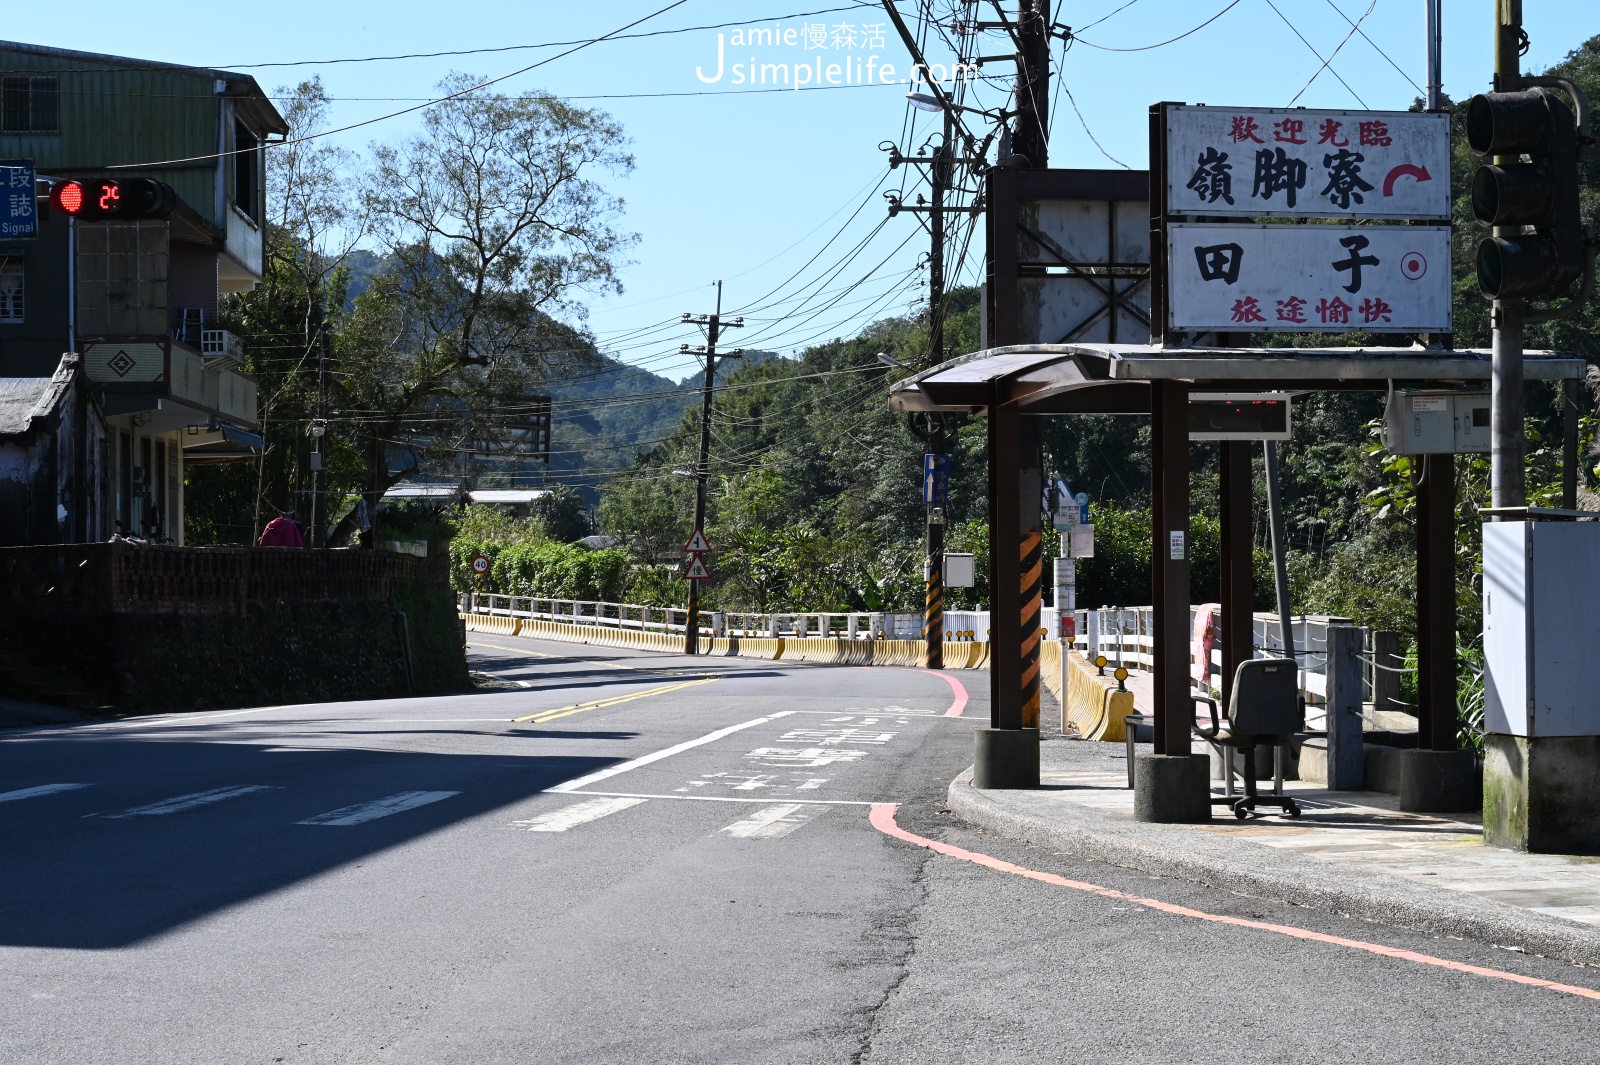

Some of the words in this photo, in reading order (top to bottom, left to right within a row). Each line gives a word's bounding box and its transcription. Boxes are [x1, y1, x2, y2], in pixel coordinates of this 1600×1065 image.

[1228, 116, 1393, 148] 歡迎光臨
[0, 168, 31, 188] 段
[9, 193, 32, 217] 誌
[2, 222, 34, 235] Signal
[1230, 296, 1393, 324] 旅途愉快
[693, 565, 702, 576] 慢
